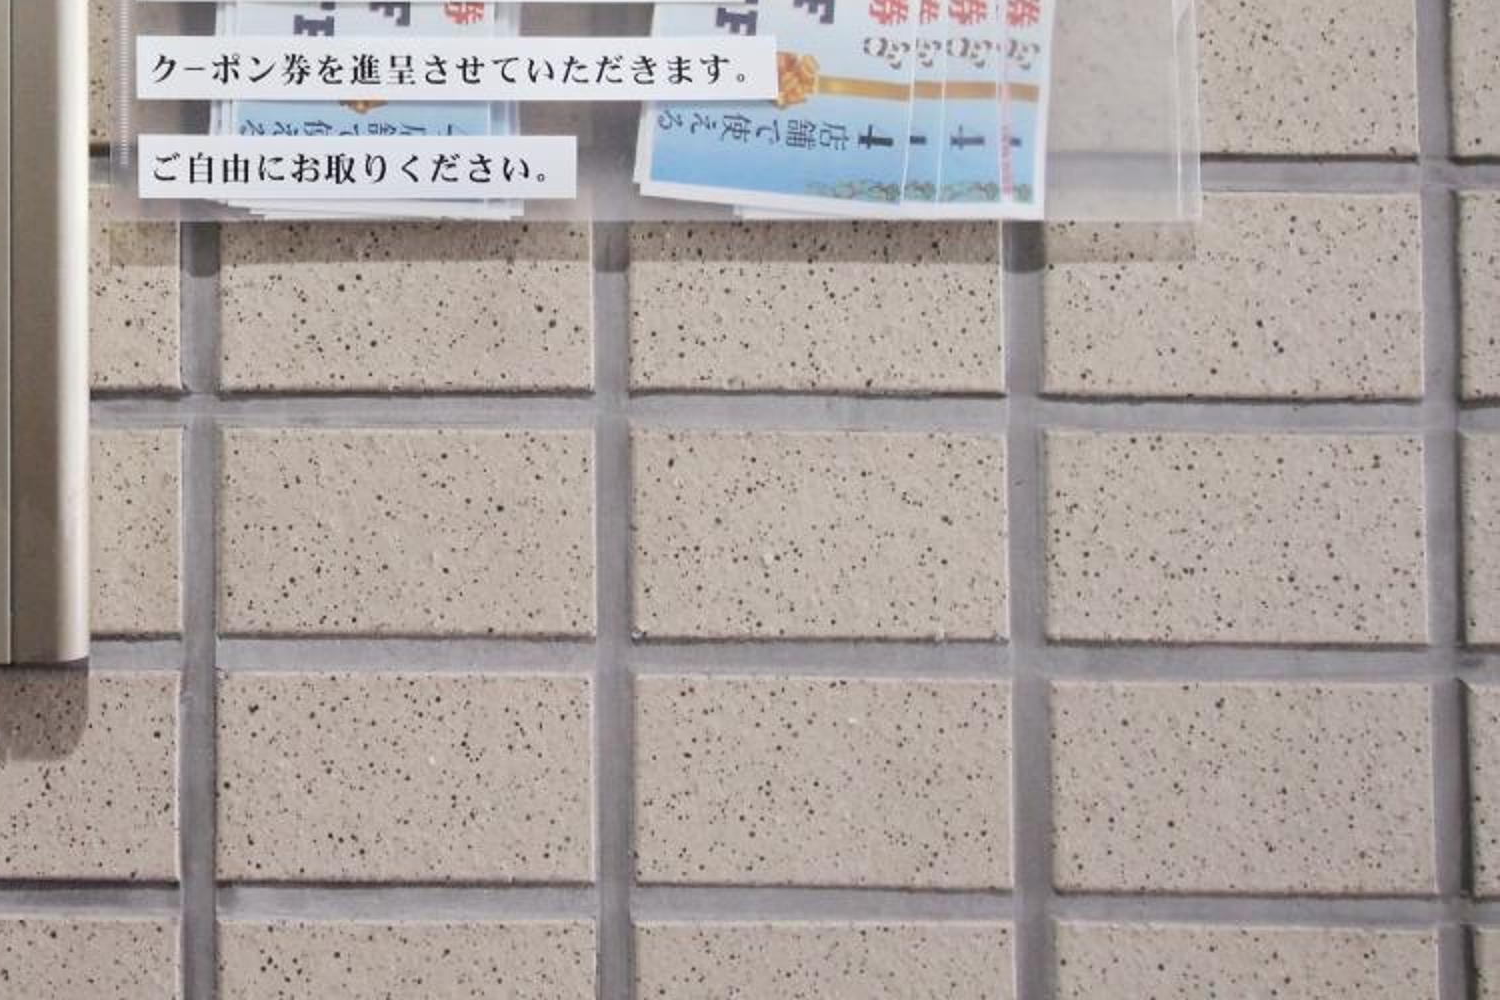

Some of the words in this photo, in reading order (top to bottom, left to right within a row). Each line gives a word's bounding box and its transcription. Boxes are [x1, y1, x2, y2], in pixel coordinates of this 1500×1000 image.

[149, 52, 747, 87] クーポン券を進呈させていただきます。
[153, 151, 546, 186] ご自由にお取りください。
